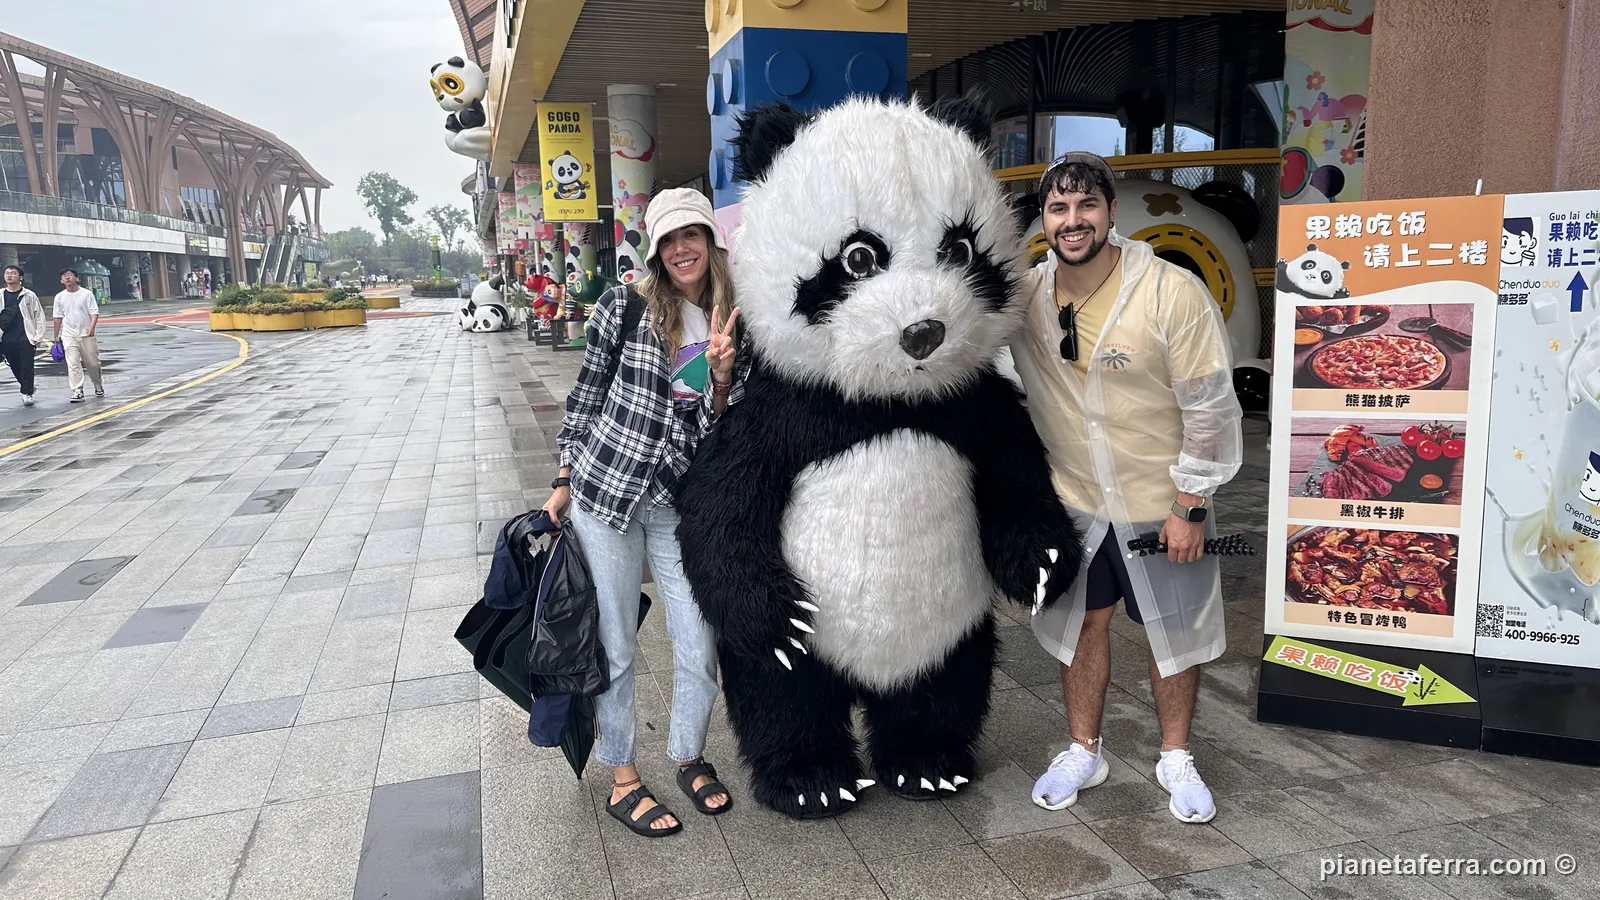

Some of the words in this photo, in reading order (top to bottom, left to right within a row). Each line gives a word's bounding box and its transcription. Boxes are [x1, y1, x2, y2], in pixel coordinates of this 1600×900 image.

[548, 111, 580, 122] GOGO
[548, 124, 581, 133] PANDA
[1549, 212, 1567, 221] Guo
[1570, 211, 1580, 220] lai
[1585, 210, 1599, 220] chi
[1306, 211, 1427, 240] 果赖吃饭
[1549, 221, 1599, 242] 果赖吃
[1363, 240, 1488, 269] 请上二楼
[1548, 247, 1600, 268] 请上二
[1345, 393, 1411, 408] 熊猫披萨
[1340, 504, 1404, 519] 黑椒牛排
[1327, 610, 1407, 629] 特色冒烤鸭
[1505, 629, 1580, 645] 400-9966-925
[1276, 645, 1409, 692] 果赖吃饭
